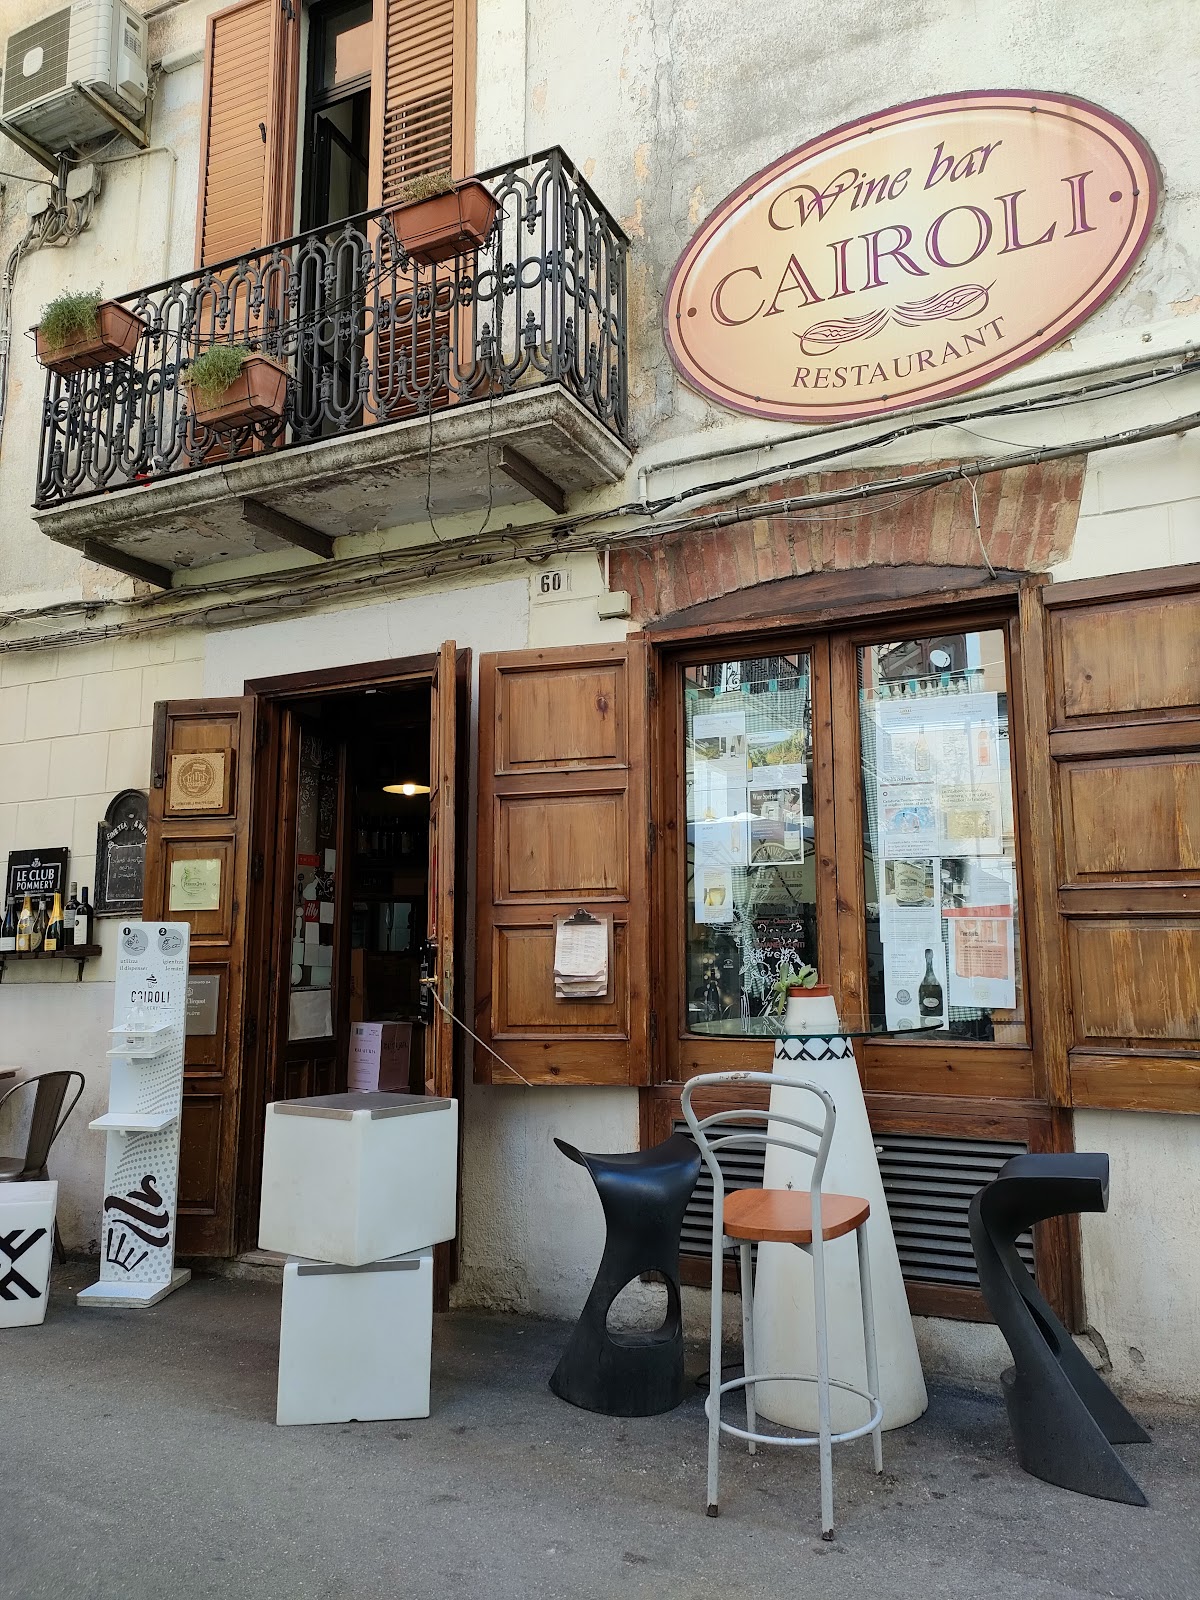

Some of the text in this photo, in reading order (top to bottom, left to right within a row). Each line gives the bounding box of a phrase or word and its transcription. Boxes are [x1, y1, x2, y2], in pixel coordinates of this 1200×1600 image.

[768, 138, 1004, 231] Wine bar
[709, 170, 1098, 327] CAIROLI
[791, 316, 1006, 390] RESTAURANT
[540, 572, 562, 593] 60
[106, 829, 119, 841] FINE
[117, 821, 128, 833] TEA
[16, 868, 55, 882] LE CLUB
[751, 870, 803, 880] CHABLIS
[16, 880, 54, 891] POMMERY
[305, 902, 319, 919] illy
